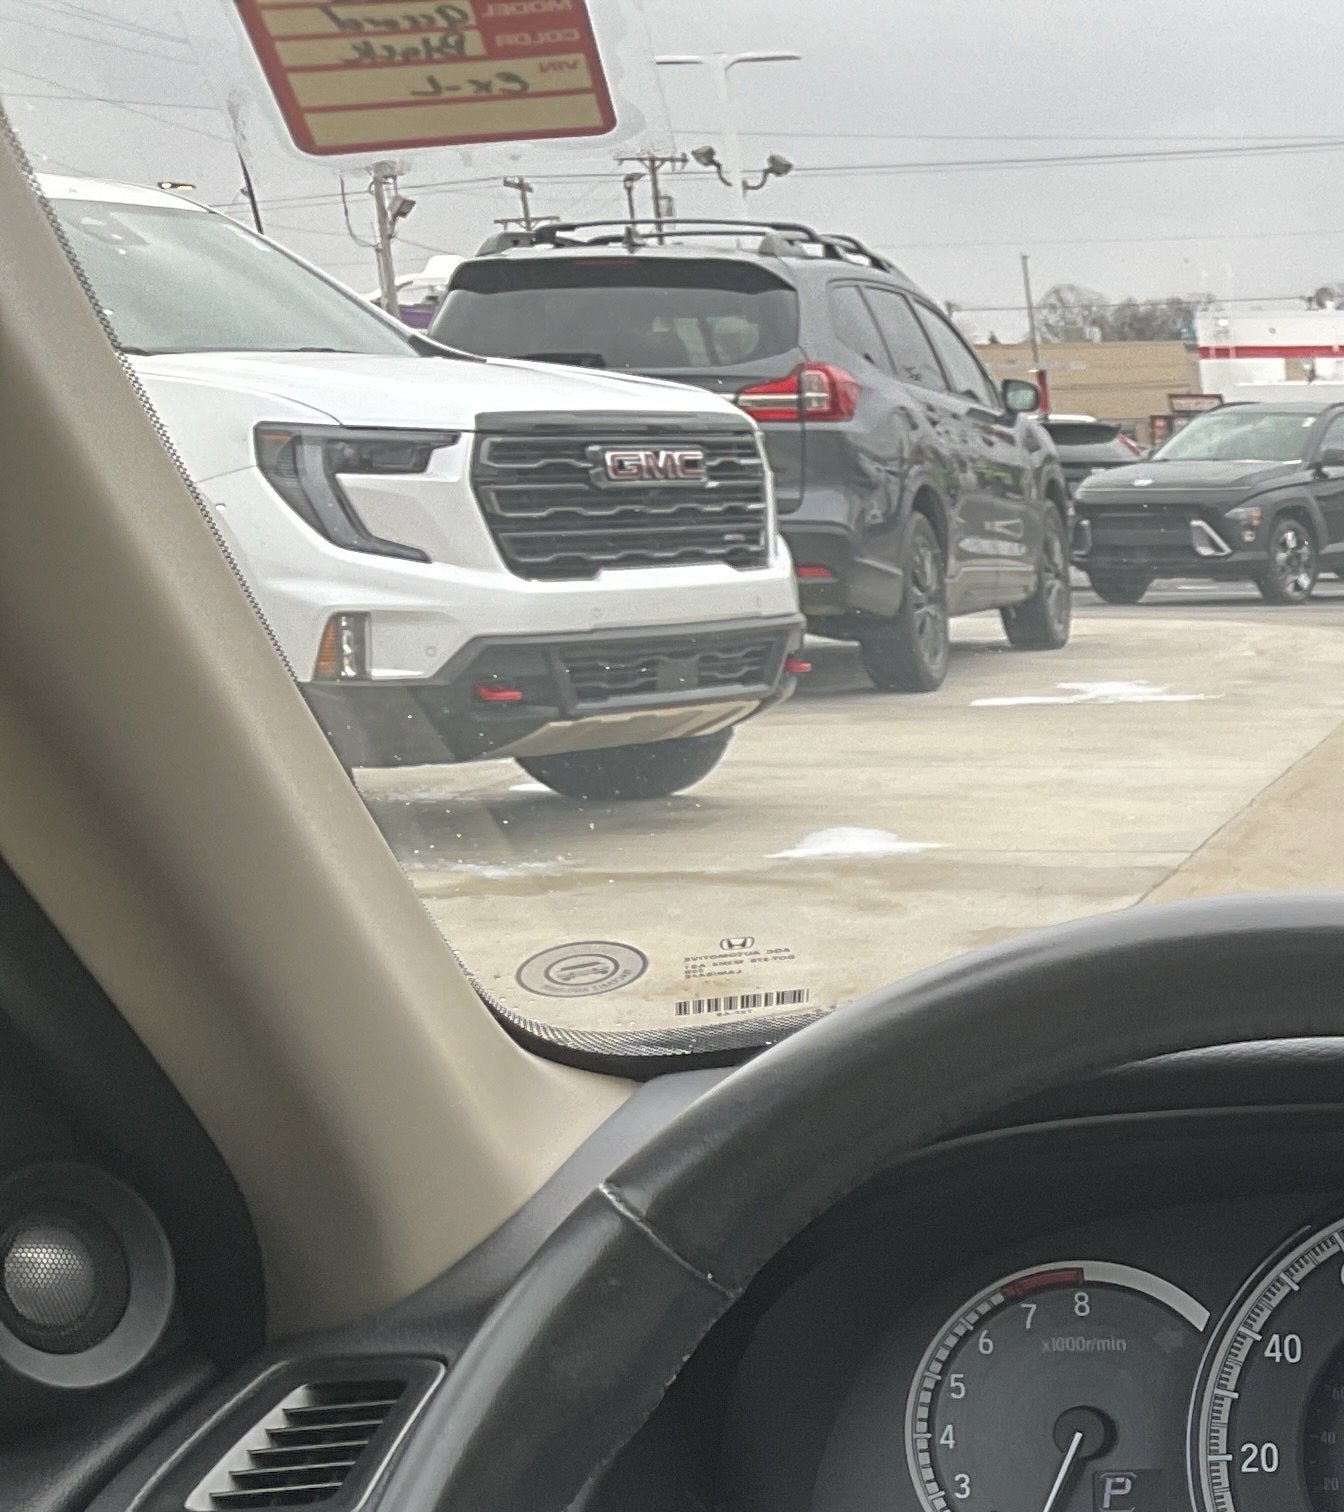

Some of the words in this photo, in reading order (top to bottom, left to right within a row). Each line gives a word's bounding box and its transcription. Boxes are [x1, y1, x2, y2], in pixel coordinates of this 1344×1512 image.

[604, 450, 707, 480] GMC
[1020, 1303, 1038, 1329] 7
[1073, 1291, 1091, 1317] 8
[977, 1329, 994, 1355] 6
[1263, 1333, 1302, 1363] 40
[949, 1373, 966, 1399] 5
[939, 1424, 956, 1449] 4
[1240, 1442, 1280, 1473] 20
[954, 1473, 971, 1499] 3
[1102, 1476, 1132, 1509] P
